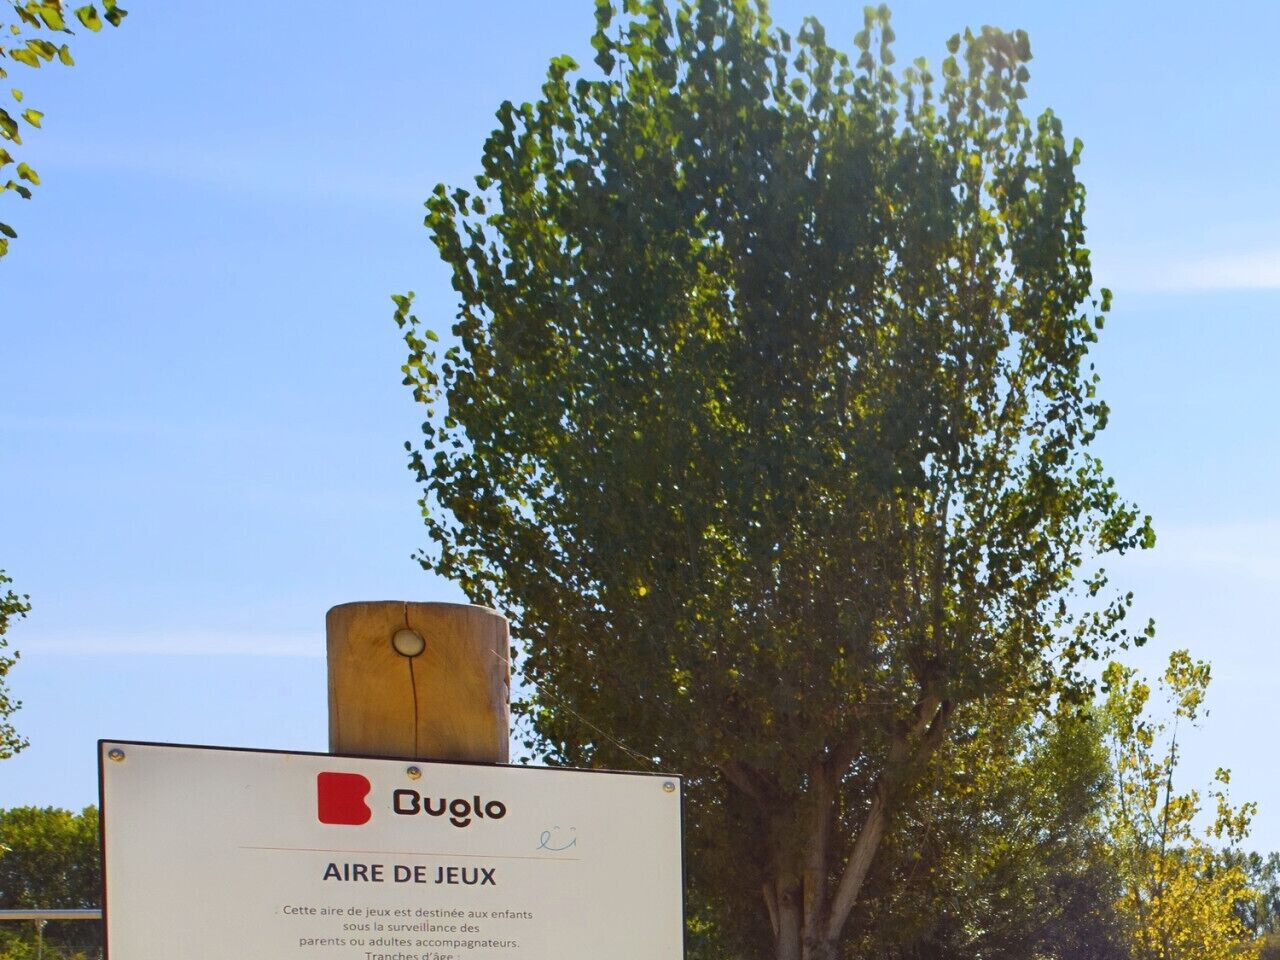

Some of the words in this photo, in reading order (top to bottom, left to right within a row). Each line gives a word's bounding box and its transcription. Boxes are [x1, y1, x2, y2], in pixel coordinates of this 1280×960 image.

[393, 789, 507, 828] Buglo
[323, 862, 384, 882] AIRE
[394, 865, 427, 884] DE
[434, 866, 497, 886] JEUX
[283, 905, 317, 915] Cette
[320, 906, 343, 916] aire
[347, 907, 362, 916] de
[365, 907, 390, 918] jeux
[394, 908, 411, 917] est
[415, 908, 465, 918] destinée
[468, 910, 488, 919] aux
[491, 909, 533, 919] enfants
[343, 923, 370, 931] sous
[374, 922, 384, 931] la
[388, 922, 457, 932] surveillance
[460, 924, 480, 933] des
[299, 938, 346, 947] parents
[368, 937, 412, 947] adultes
[416, 939, 520, 950] accompagnateurs.
